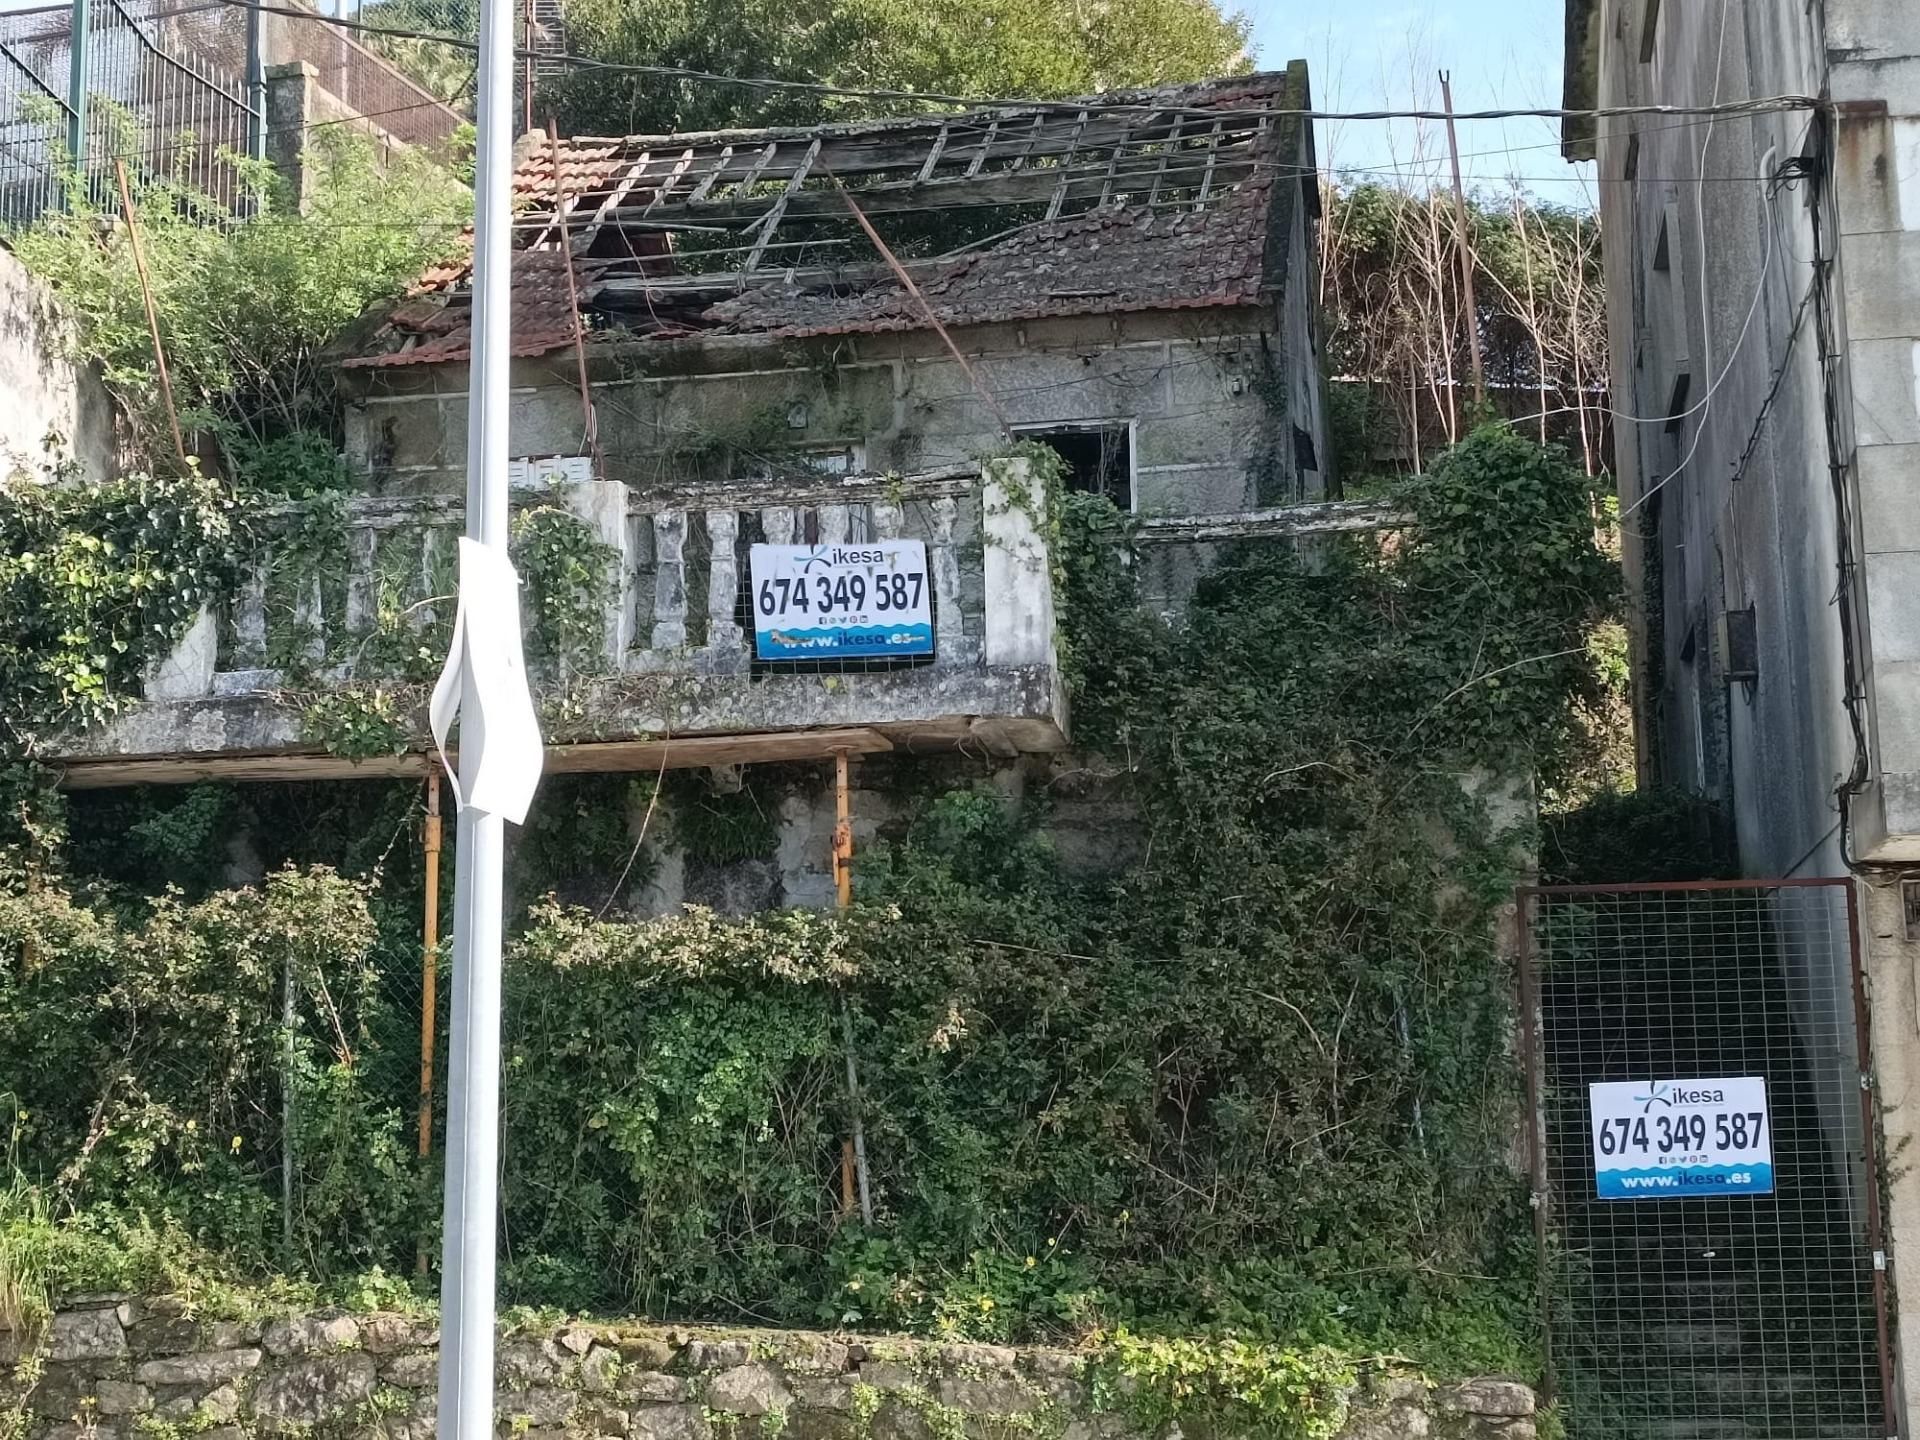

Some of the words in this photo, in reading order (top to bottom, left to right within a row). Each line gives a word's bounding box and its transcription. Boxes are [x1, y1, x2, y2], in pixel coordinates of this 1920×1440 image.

[832, 548, 884, 565] ikesa
[759, 578, 809, 616] 674
[816, 574, 866, 613] 349
[875, 572, 923, 611] 587
[1672, 1087, 1724, 1104] ikesa
[1599, 1118, 1649, 1155] 674
[1656, 1114, 1706, 1153] 349
[1715, 1112, 1763, 1151] 587
[1621, 1171, 1752, 1189] www.ikesa.es
